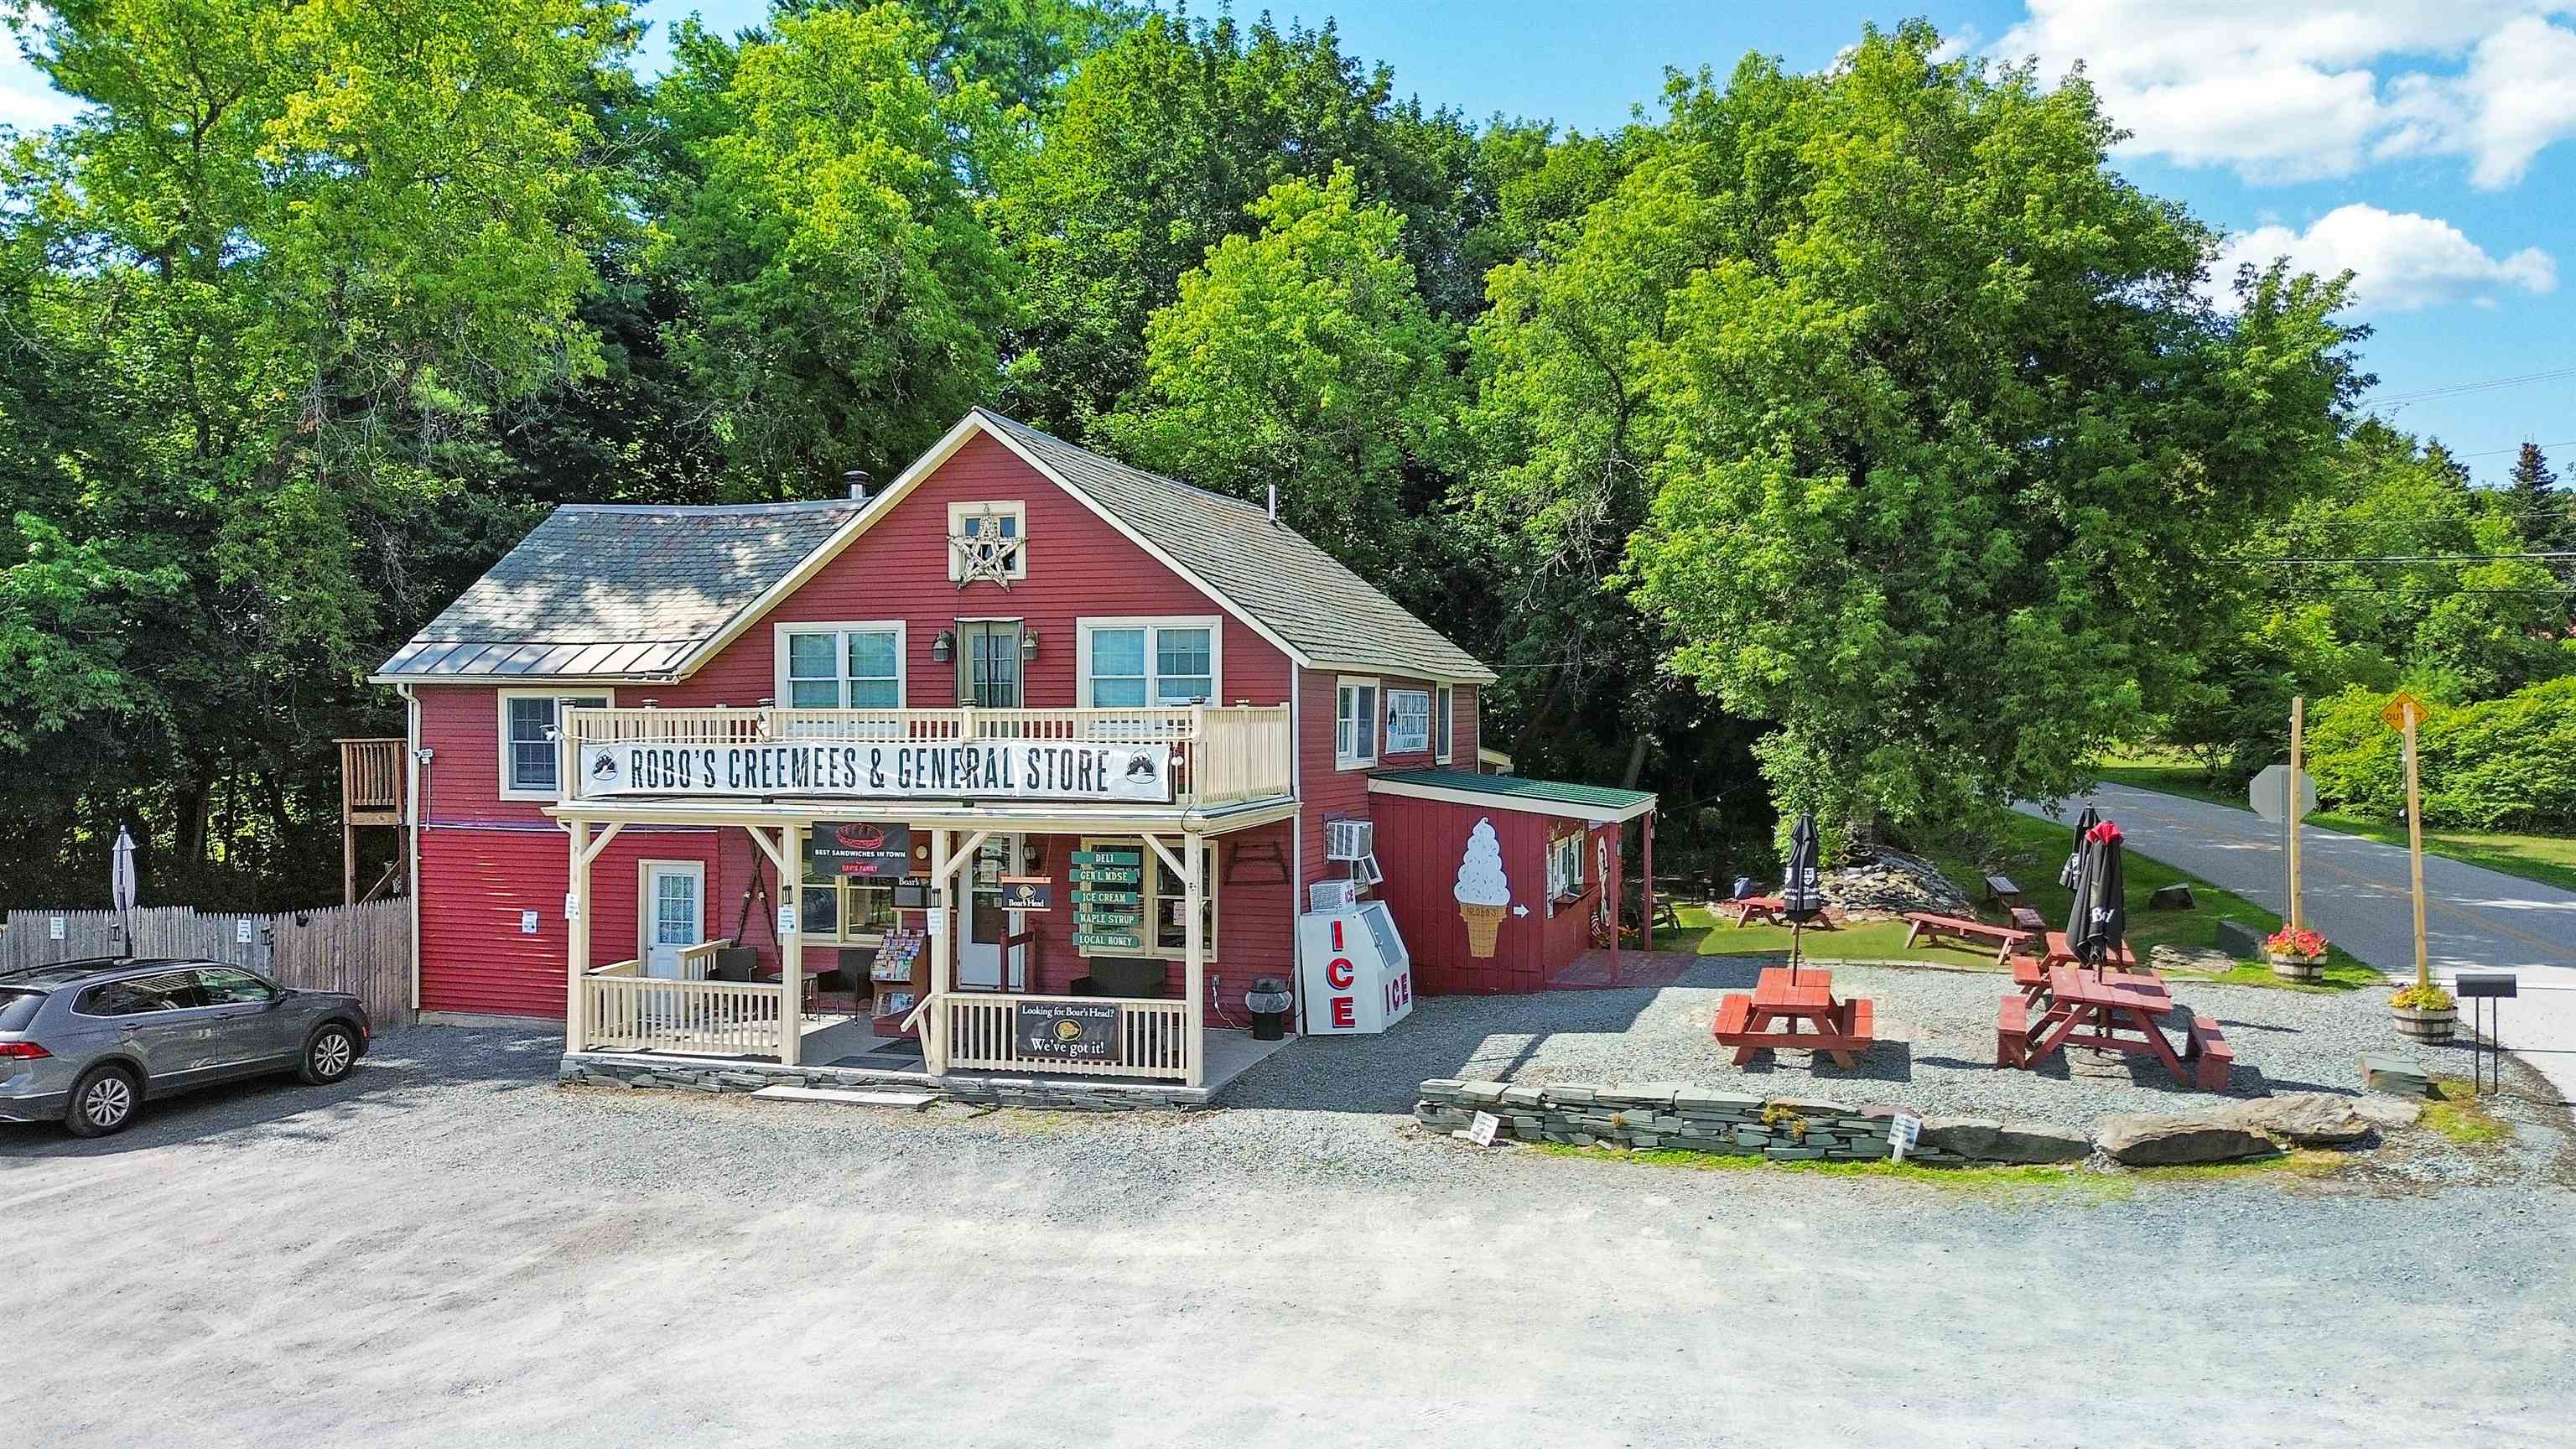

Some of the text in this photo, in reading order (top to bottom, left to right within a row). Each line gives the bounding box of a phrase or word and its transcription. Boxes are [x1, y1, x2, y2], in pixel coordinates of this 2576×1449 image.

[2386, 713, 2423, 721] OUTT
[631, 746, 1110, 792] ROBO'S CREEMEES & GENERAL STORE
[814, 849, 831, 857] BEST
[831, 849, 875, 858] SANDWICHES
[886, 850, 906, 859] TOWN
[1095, 853, 1114, 864] DELI
[1105, 871, 1128, 881] MDSE
[1027, 899, 1045, 907] Head
[1083, 892, 1126, 903] ICE CREAM
[1079, 913, 1135, 924] MAPLE SYRUP
[1079, 935, 1133, 947] LOCAL HONEY
[1326, 920, 1357, 1029] ICE
[1385, 972, 1409, 1015] ICE
[1022, 1005, 1115, 1018] Looking for Boar's Head?
[1031, 1038, 1105, 1057] We've got it!
